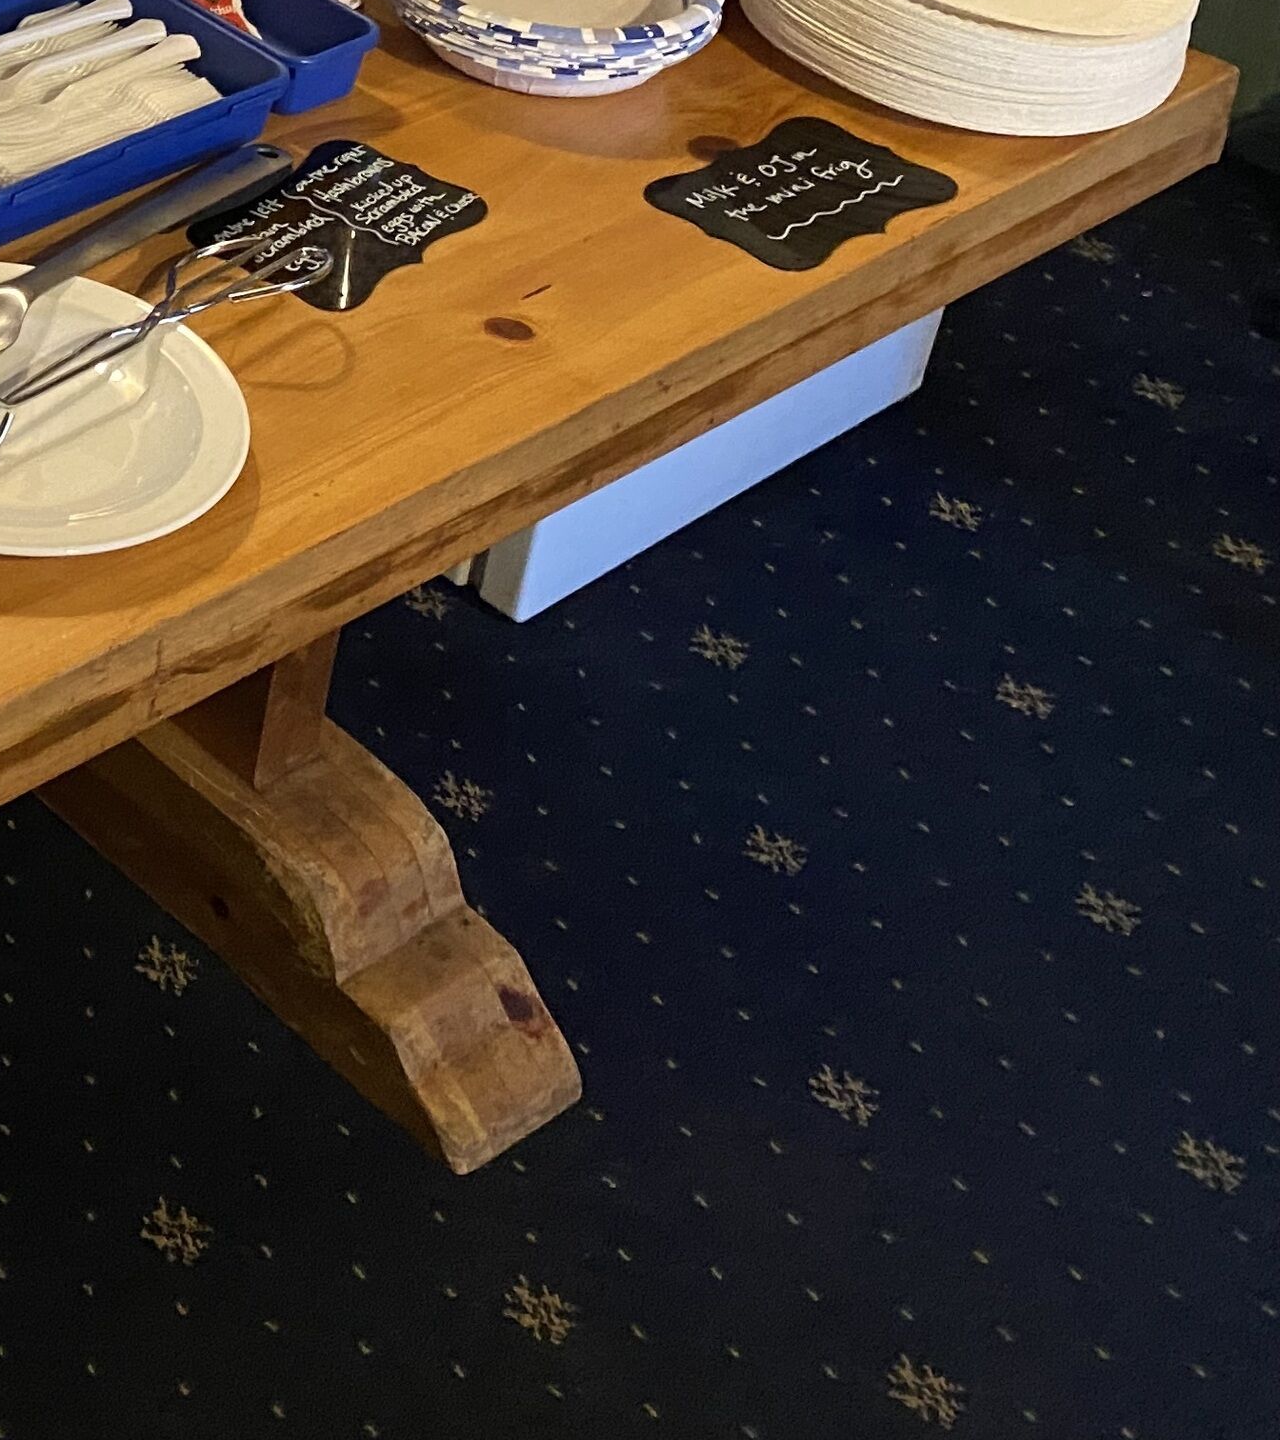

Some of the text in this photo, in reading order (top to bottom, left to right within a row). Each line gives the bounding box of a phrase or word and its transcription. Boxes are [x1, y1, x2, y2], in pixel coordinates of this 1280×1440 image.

[686, 184, 739, 208] Milk
[758, 155, 797, 177] OJ
[725, 203, 768, 222] the
